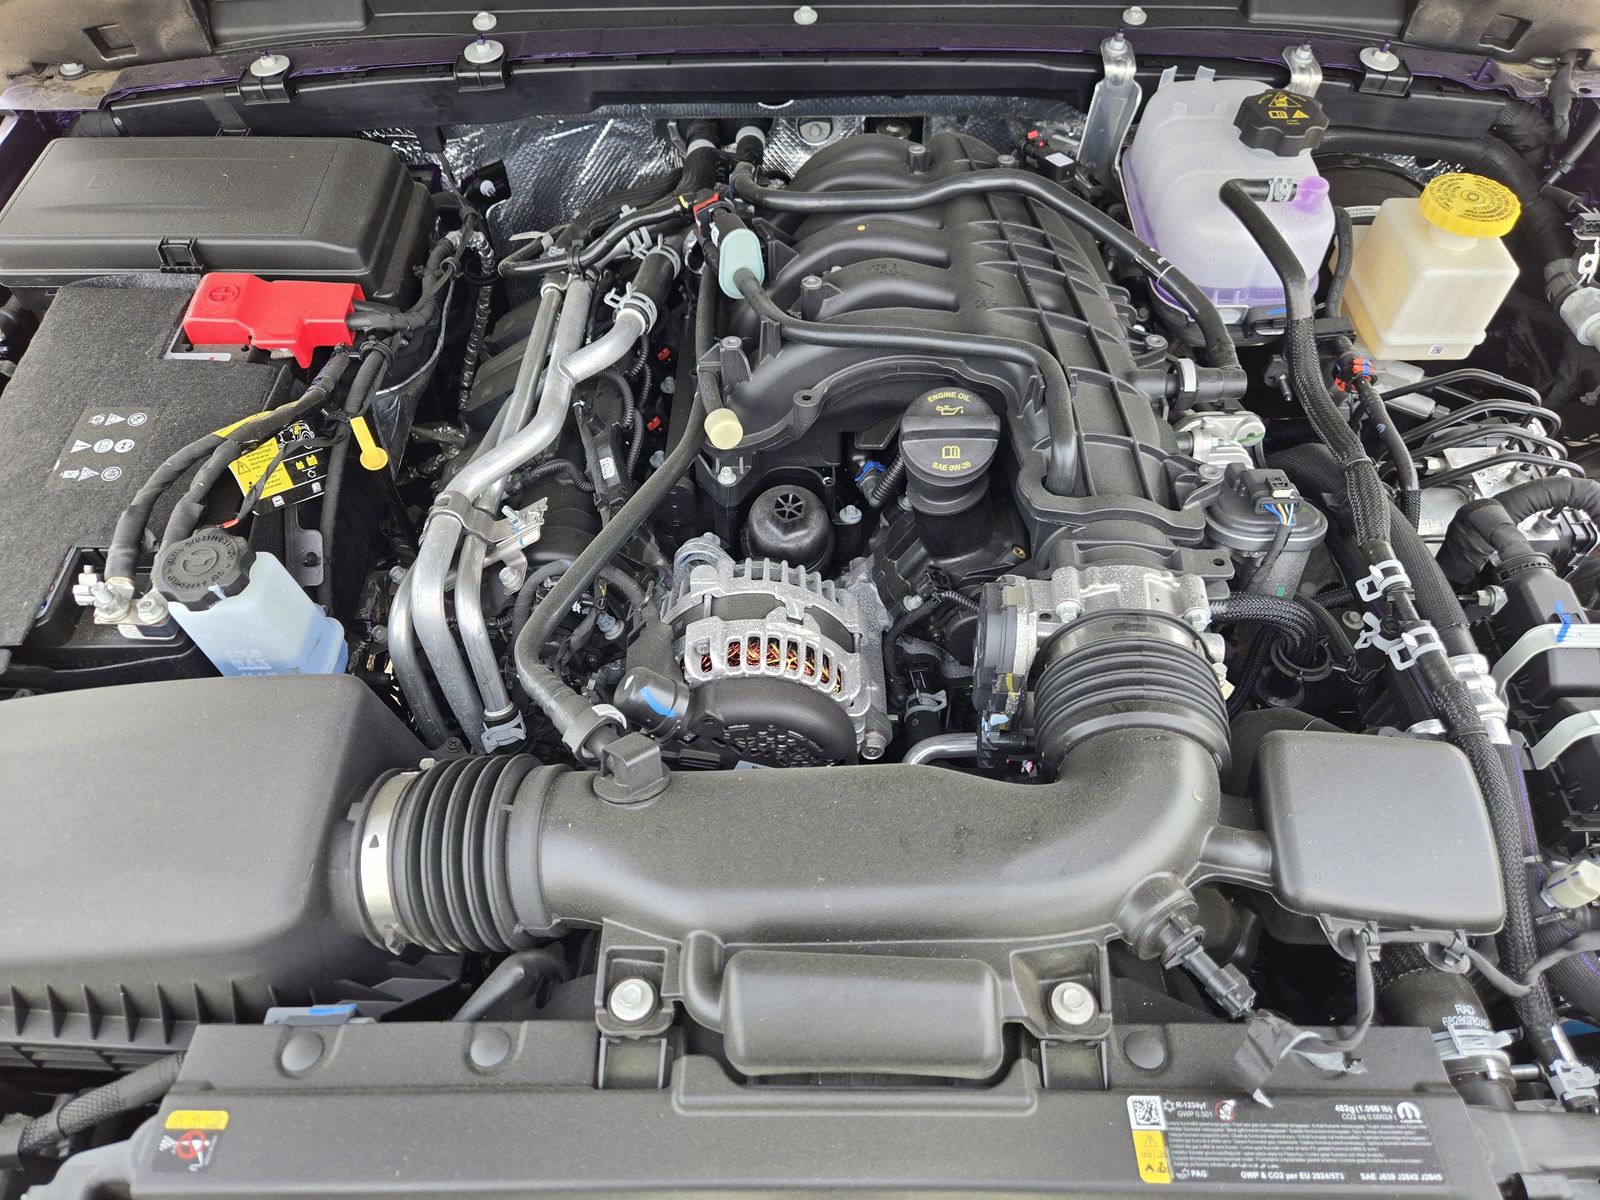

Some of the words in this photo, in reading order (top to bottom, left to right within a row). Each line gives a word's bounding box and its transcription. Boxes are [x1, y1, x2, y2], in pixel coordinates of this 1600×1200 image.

[927, 391, 957, 403] ENGINE
[958, 393, 970, 402] OIL
[932, 461, 948, 471] SAE
[949, 461, 972, 471] 0W-20
[1454, 1004, 1475, 1015] RAD
[1175, 1101, 1206, 1110] R-1234yf
[1177, 1110, 1194, 1118] GWP
[1190, 1169, 1208, 1178] PAG
[1240, 1170, 1259, 1179] GWP
[1267, 1171, 1284, 1179] CO2
[1285, 1173, 1298, 1181] per
[1298, 1171, 1311, 1180] EU
[1360, 1172, 1377, 1180] SAE
